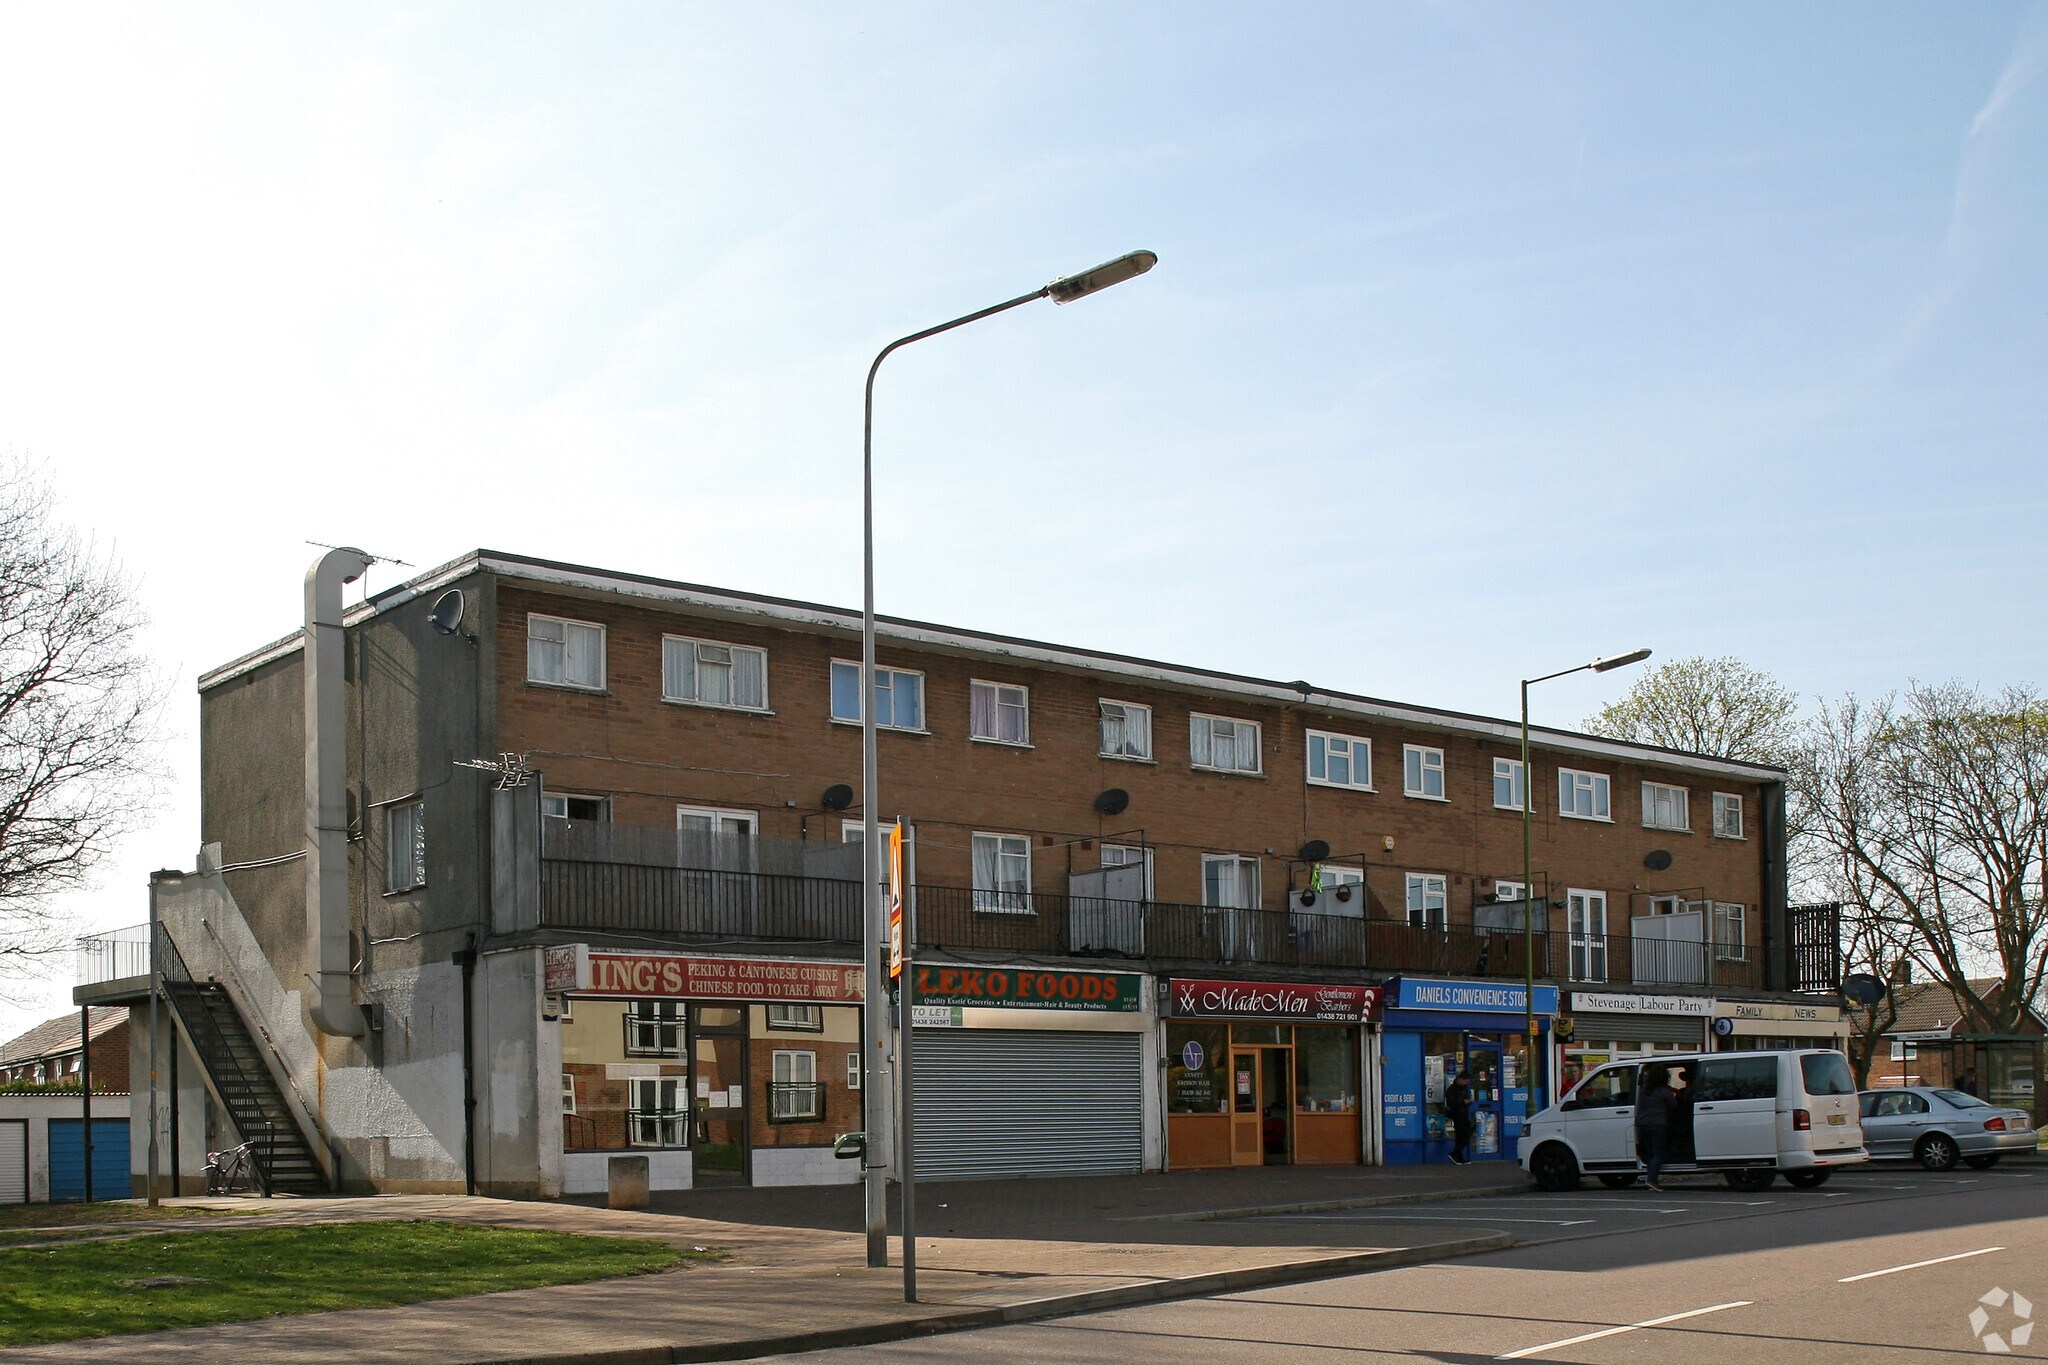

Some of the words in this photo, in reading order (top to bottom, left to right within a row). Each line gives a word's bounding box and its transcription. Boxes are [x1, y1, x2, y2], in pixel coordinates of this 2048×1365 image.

[688, 963, 726, 977] PEKING
[728, 965, 736, 977] &
[738, 965, 798, 979] CANTONESE
[800, 968, 839, 981] CUISINE
[689, 980, 735, 994] CHINESE
[736, 982, 764, 995] FOOD
[766, 983, 781, 996] TO
[782, 983, 810, 996] TAKE
[812, 985, 838, 997] AWAY
[917, 968, 1009, 997] LEKO
[1016, 972, 1118, 1001] FOODS
[924, 997, 946, 1006] Quality
[947, 997, 966, 1005] Exotic
[1064, 1002, 1083, 1010] Beauty
[1416, 986, 1450, 1004] DANIELS
[1452, 988, 1507, 1007] CONVENIENCE
[1508, 991, 1530, 1008] STOR
[1587, 994, 1636, 1011] Stevenage
[1640, 997, 1675, 1011] Labour
[1678, 999, 1703, 1014] Party
[912, 1008, 926, 1016] TO
[929, 1009, 949, 1017] LET
[1316, 1012, 1335, 1020] 01438
[1736, 1006, 1764, 1017] FAMILY
[1794, 1008, 1817, 1018] NEWS
